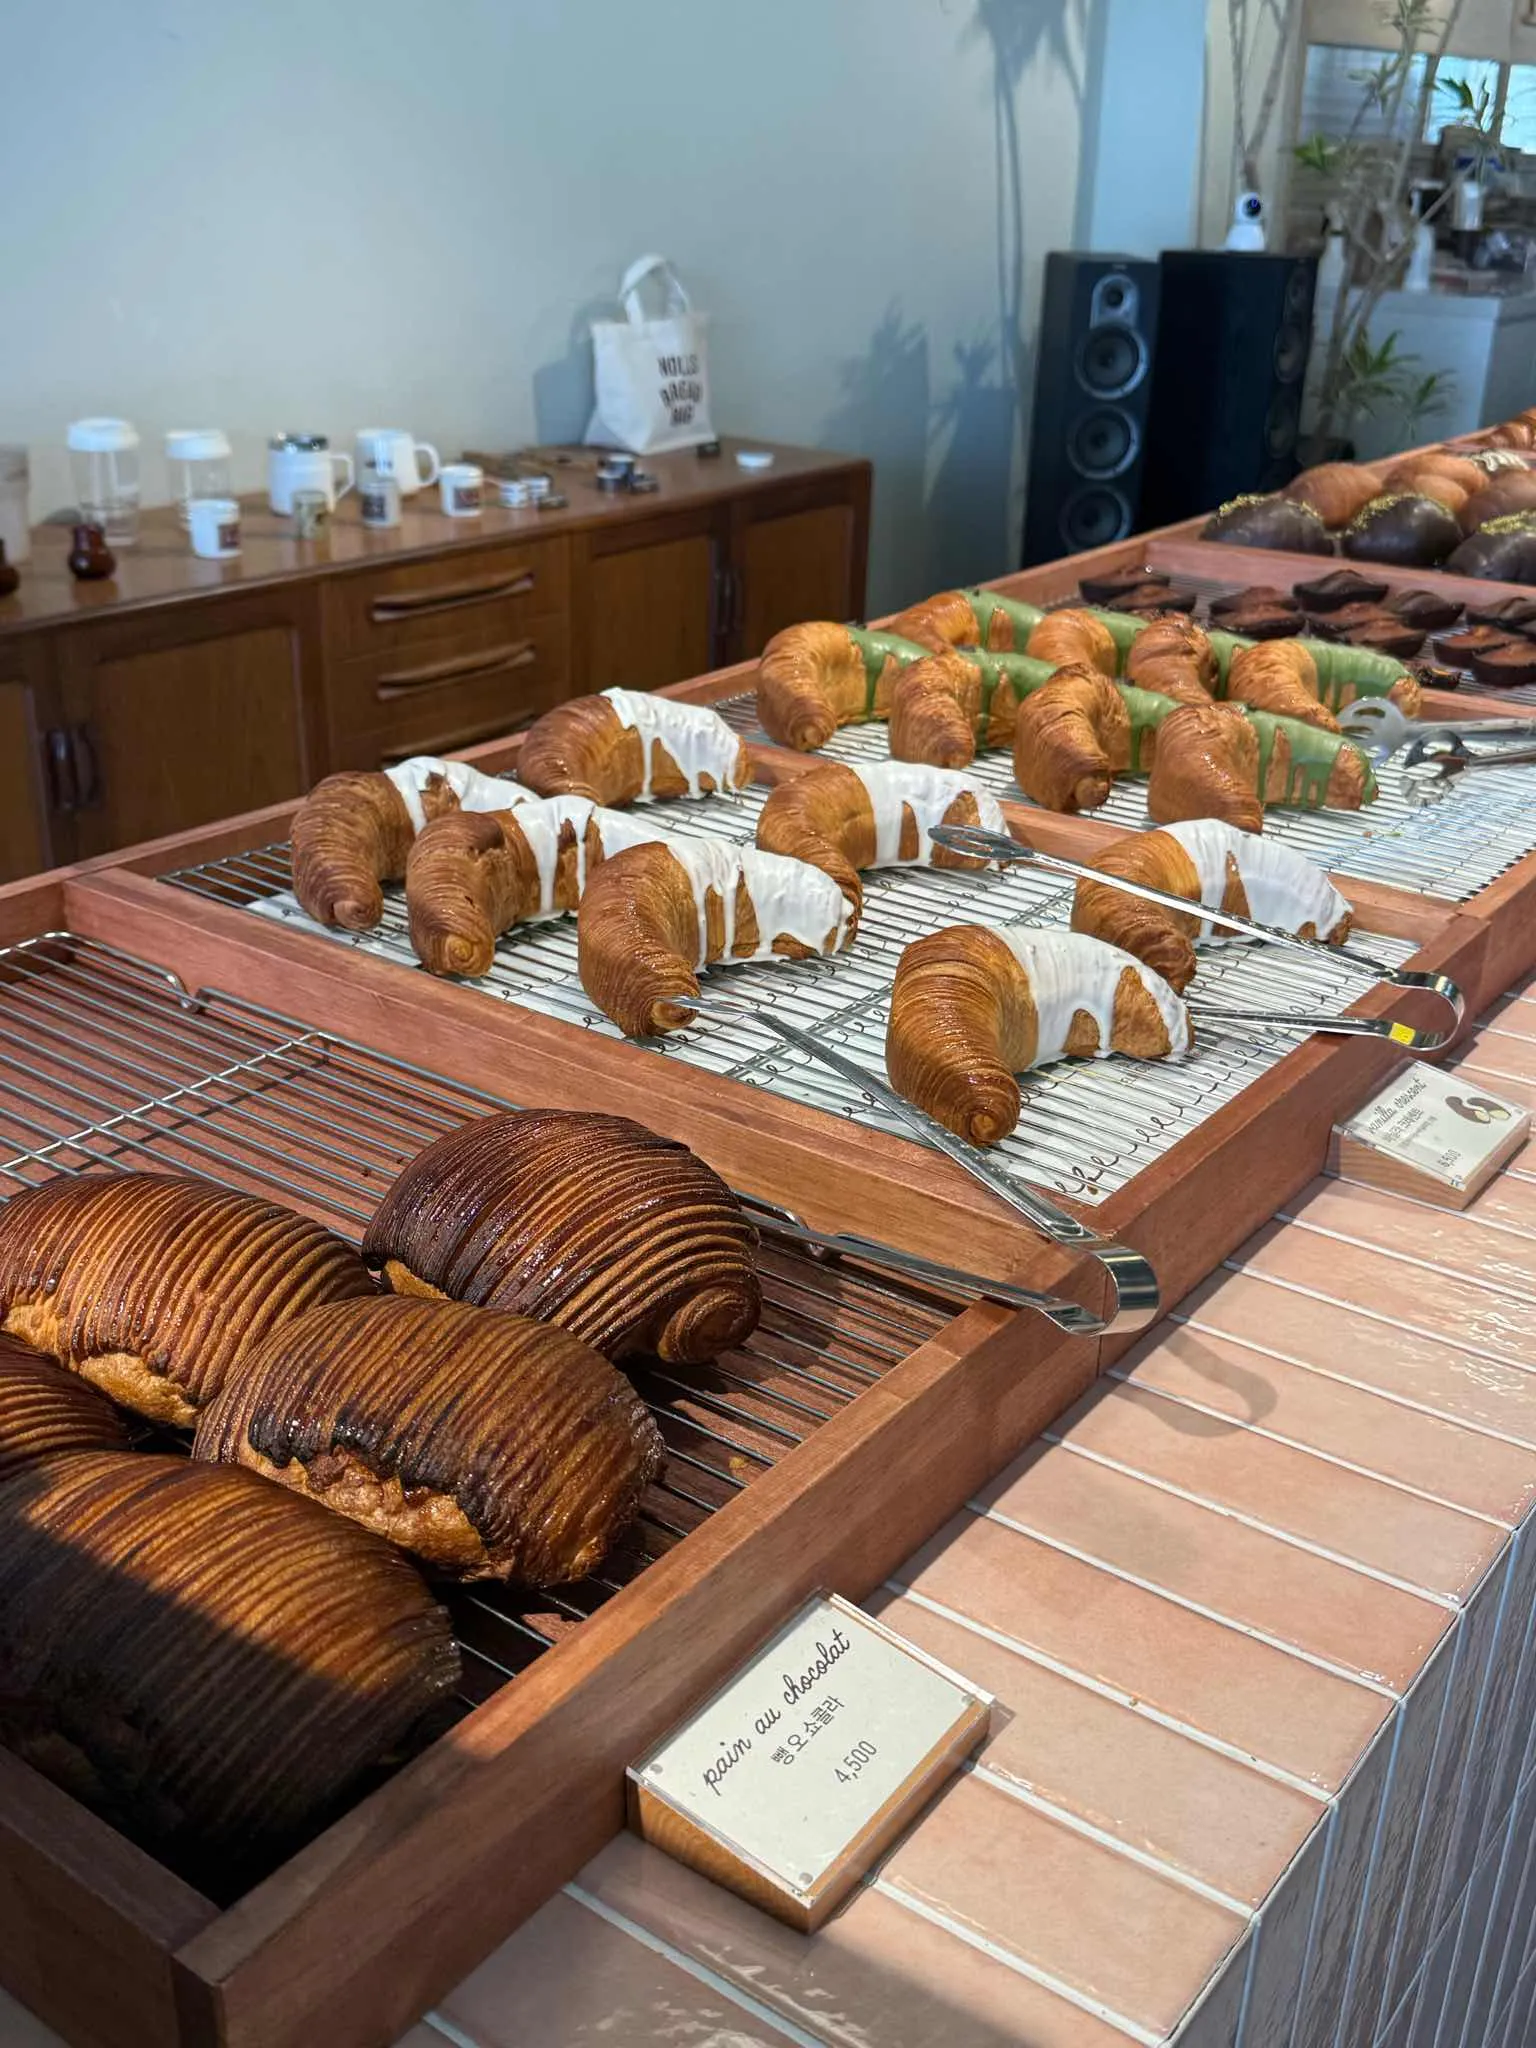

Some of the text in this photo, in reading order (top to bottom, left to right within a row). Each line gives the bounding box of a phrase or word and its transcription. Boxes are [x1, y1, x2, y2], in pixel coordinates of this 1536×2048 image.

[1367, 1105, 1397, 1134] vanilla
[703, 1628, 850, 1796] pain au chocolat
[787, 1734, 809, 1752] 오
[803, 1695, 845, 1737] 쇼콜라
[834, 1740, 878, 1783] 4,500
